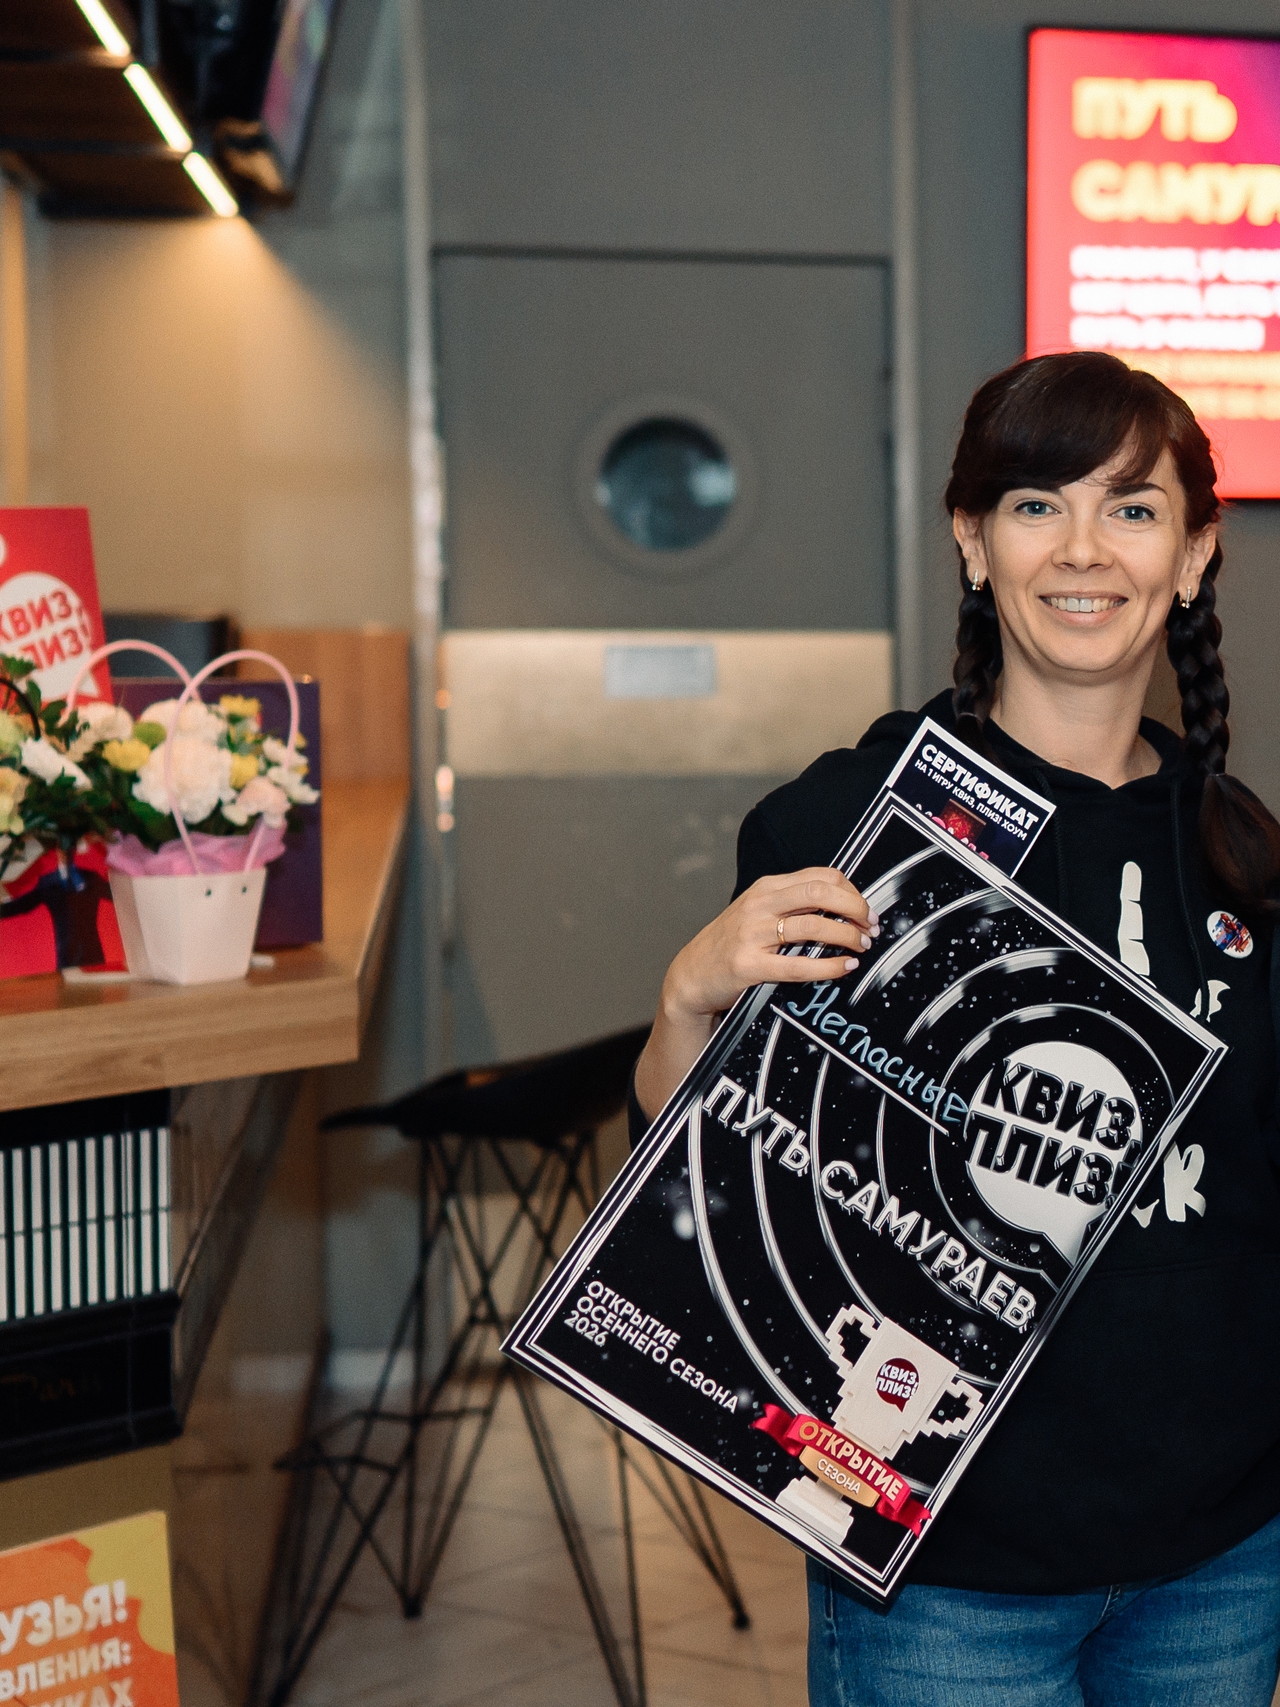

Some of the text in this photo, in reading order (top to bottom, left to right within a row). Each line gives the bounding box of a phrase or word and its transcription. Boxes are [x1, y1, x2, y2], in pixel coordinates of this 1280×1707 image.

[914, 759, 927, 774] НА
[932, 772, 954, 791] ИГРУ
[952, 785, 976, 809] КВИЗ,
[976, 801, 1003, 826] ПЛИЗ!
[1001, 819, 1028, 841] ХОУМ
[921, 744, 1039, 830] СЕРТИФИКАТ
[702, 1075, 811, 1177] ПУТЬ
[819, 1160, 1036, 1334] САМУРАЕВ
[564, 1310, 609, 1347] 2026
[577, 1296, 739, 1414] ОСЕННЕГО СЕЗОНА
[587, 1281, 681, 1351] ОТКРЫТИЕ
[799, 1421, 903, 1501] ОТКРЫТИЕ
[817, 1458, 862, 1494] СЕЗОНА
